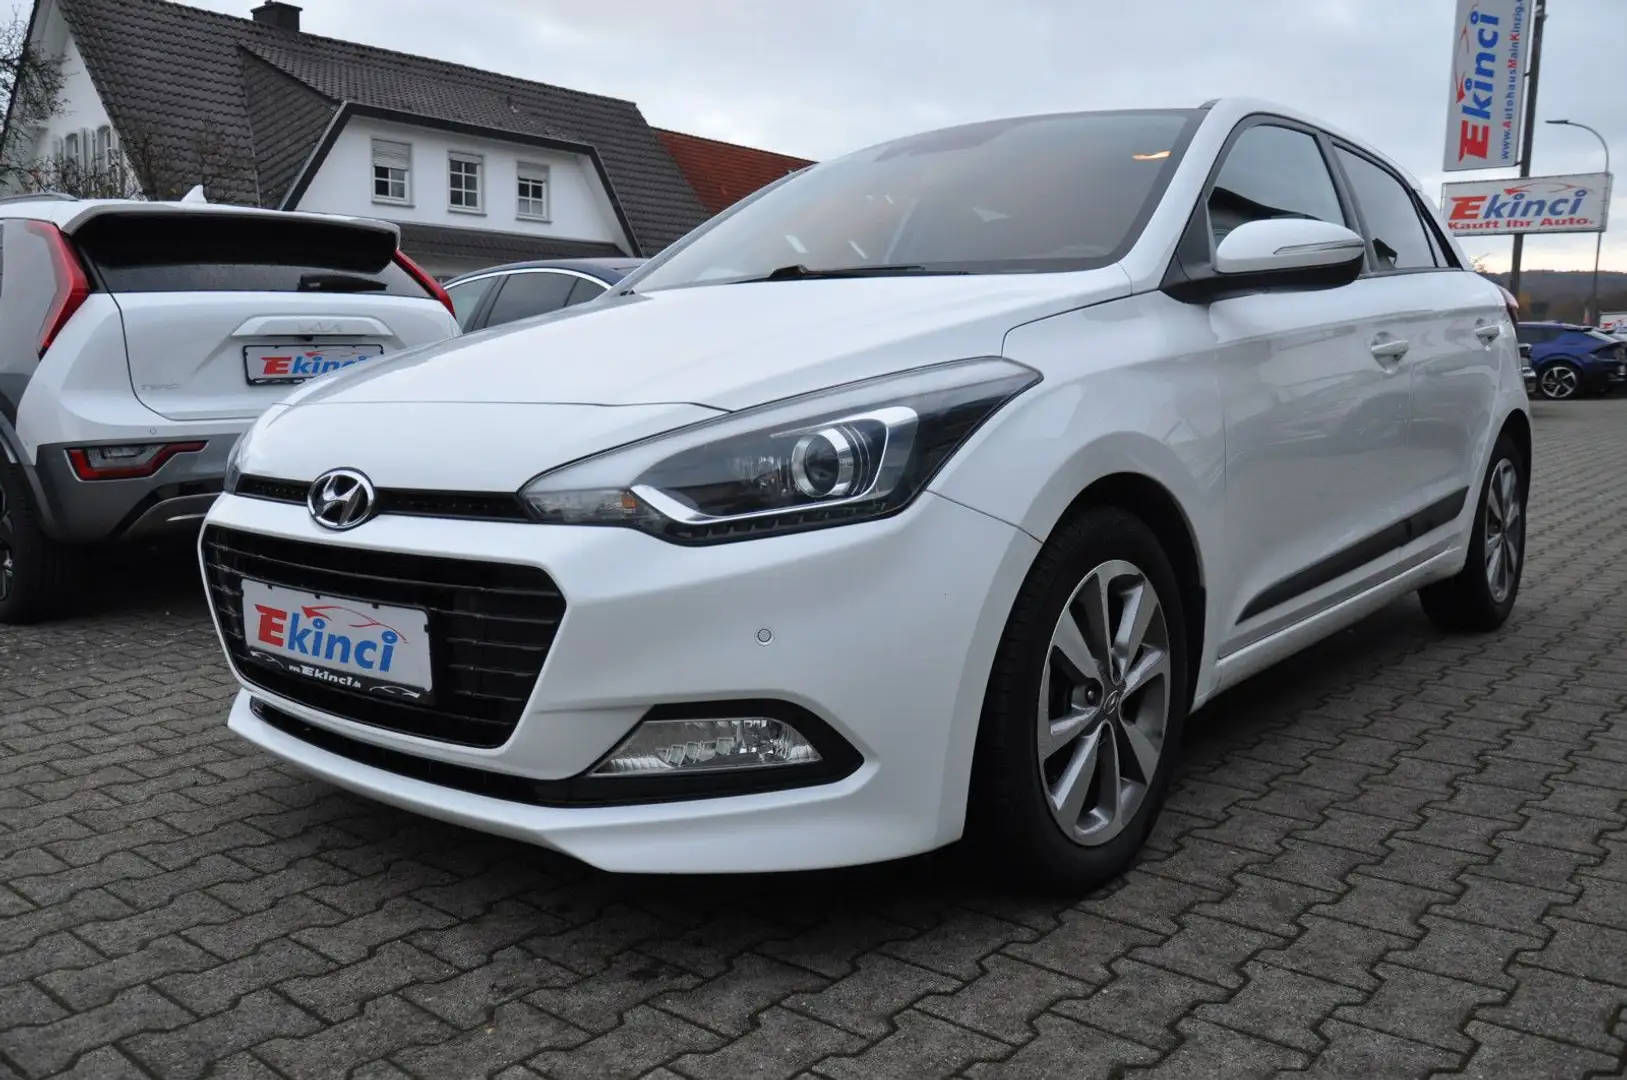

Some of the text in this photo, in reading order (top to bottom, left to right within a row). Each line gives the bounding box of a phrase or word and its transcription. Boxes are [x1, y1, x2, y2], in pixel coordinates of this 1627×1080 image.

[1458, 10, 1500, 162] Ekinci
[1449, 189, 1588, 220] Ekinci
[1506, 218, 1534, 228] Ihr
[1540, 216, 1594, 228] Auto.
[255, 604, 398, 673] Ekinci
